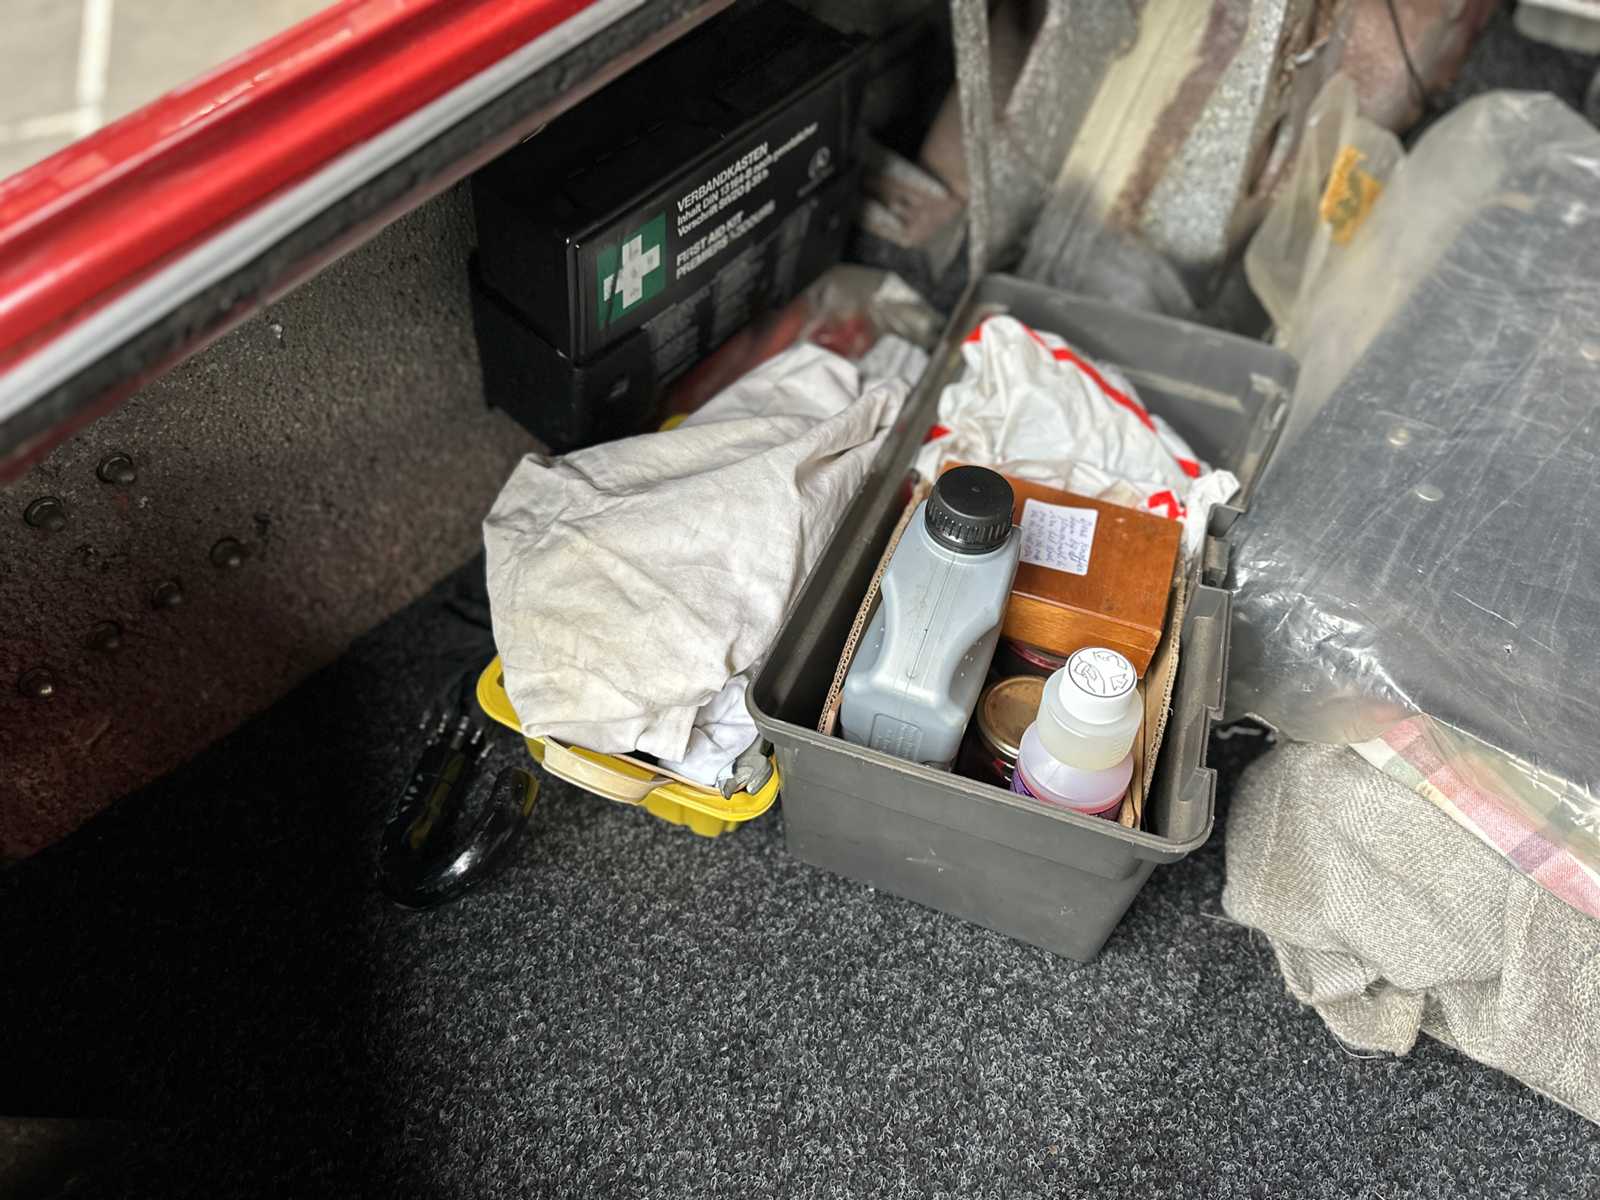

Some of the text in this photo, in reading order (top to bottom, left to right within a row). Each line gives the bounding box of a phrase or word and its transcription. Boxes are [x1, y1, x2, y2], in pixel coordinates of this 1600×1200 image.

[677, 141, 768, 212] VERBANDKASTEN
[677, 203, 701, 226] Inhalt
[702, 190, 719, 209] DIN
[677, 203, 718, 237] Vorschrift
[677, 236, 707, 267] FIRST
[707, 225, 725, 245] AID
[726, 210, 744, 231] KIT
